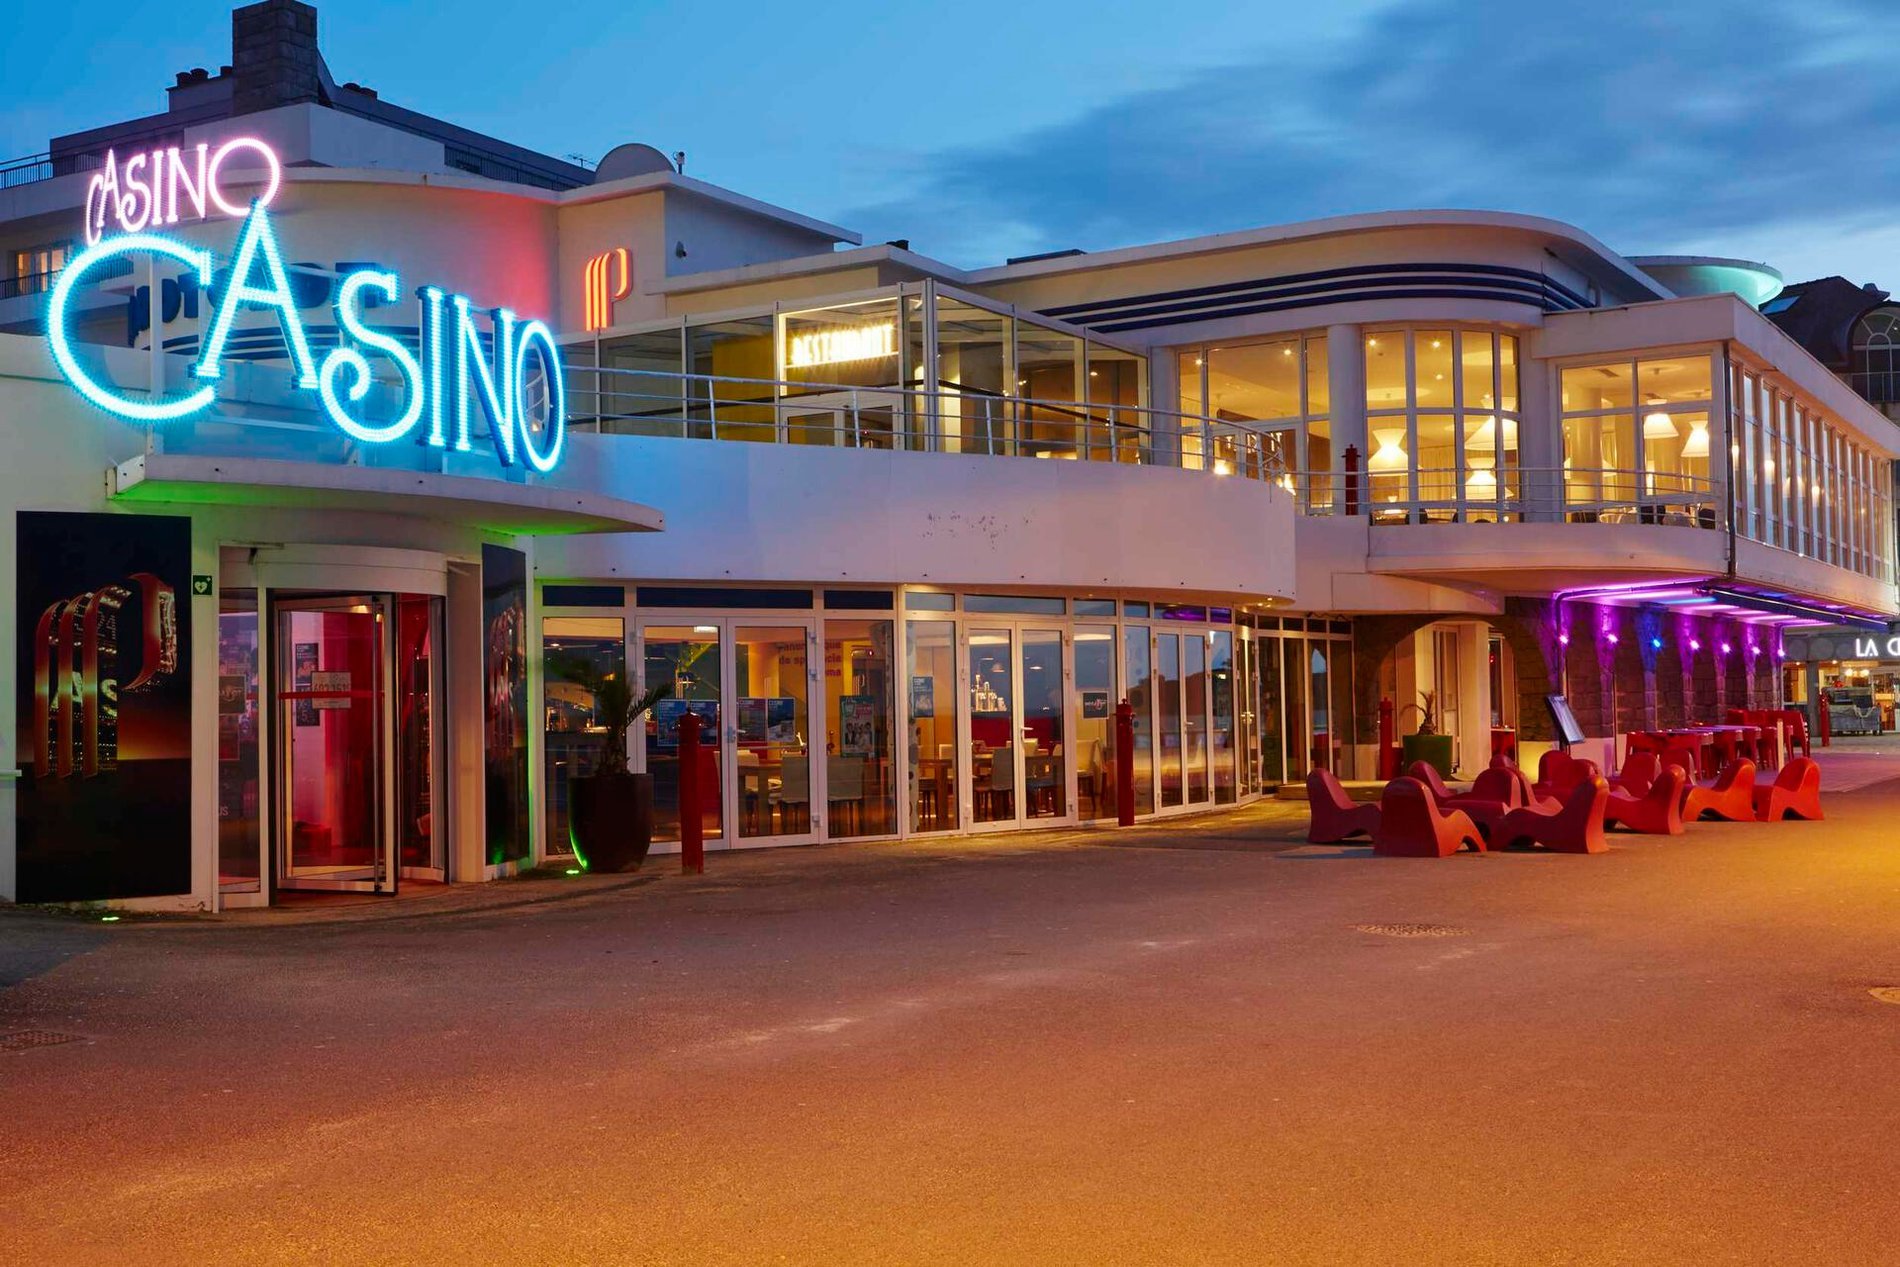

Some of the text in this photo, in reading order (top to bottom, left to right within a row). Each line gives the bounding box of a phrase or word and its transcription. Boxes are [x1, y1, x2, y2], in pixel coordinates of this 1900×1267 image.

[86, 137, 280, 247] CASINO
[48, 199, 566, 472] CASINO
[1855, 637, 1879, 658] LA
